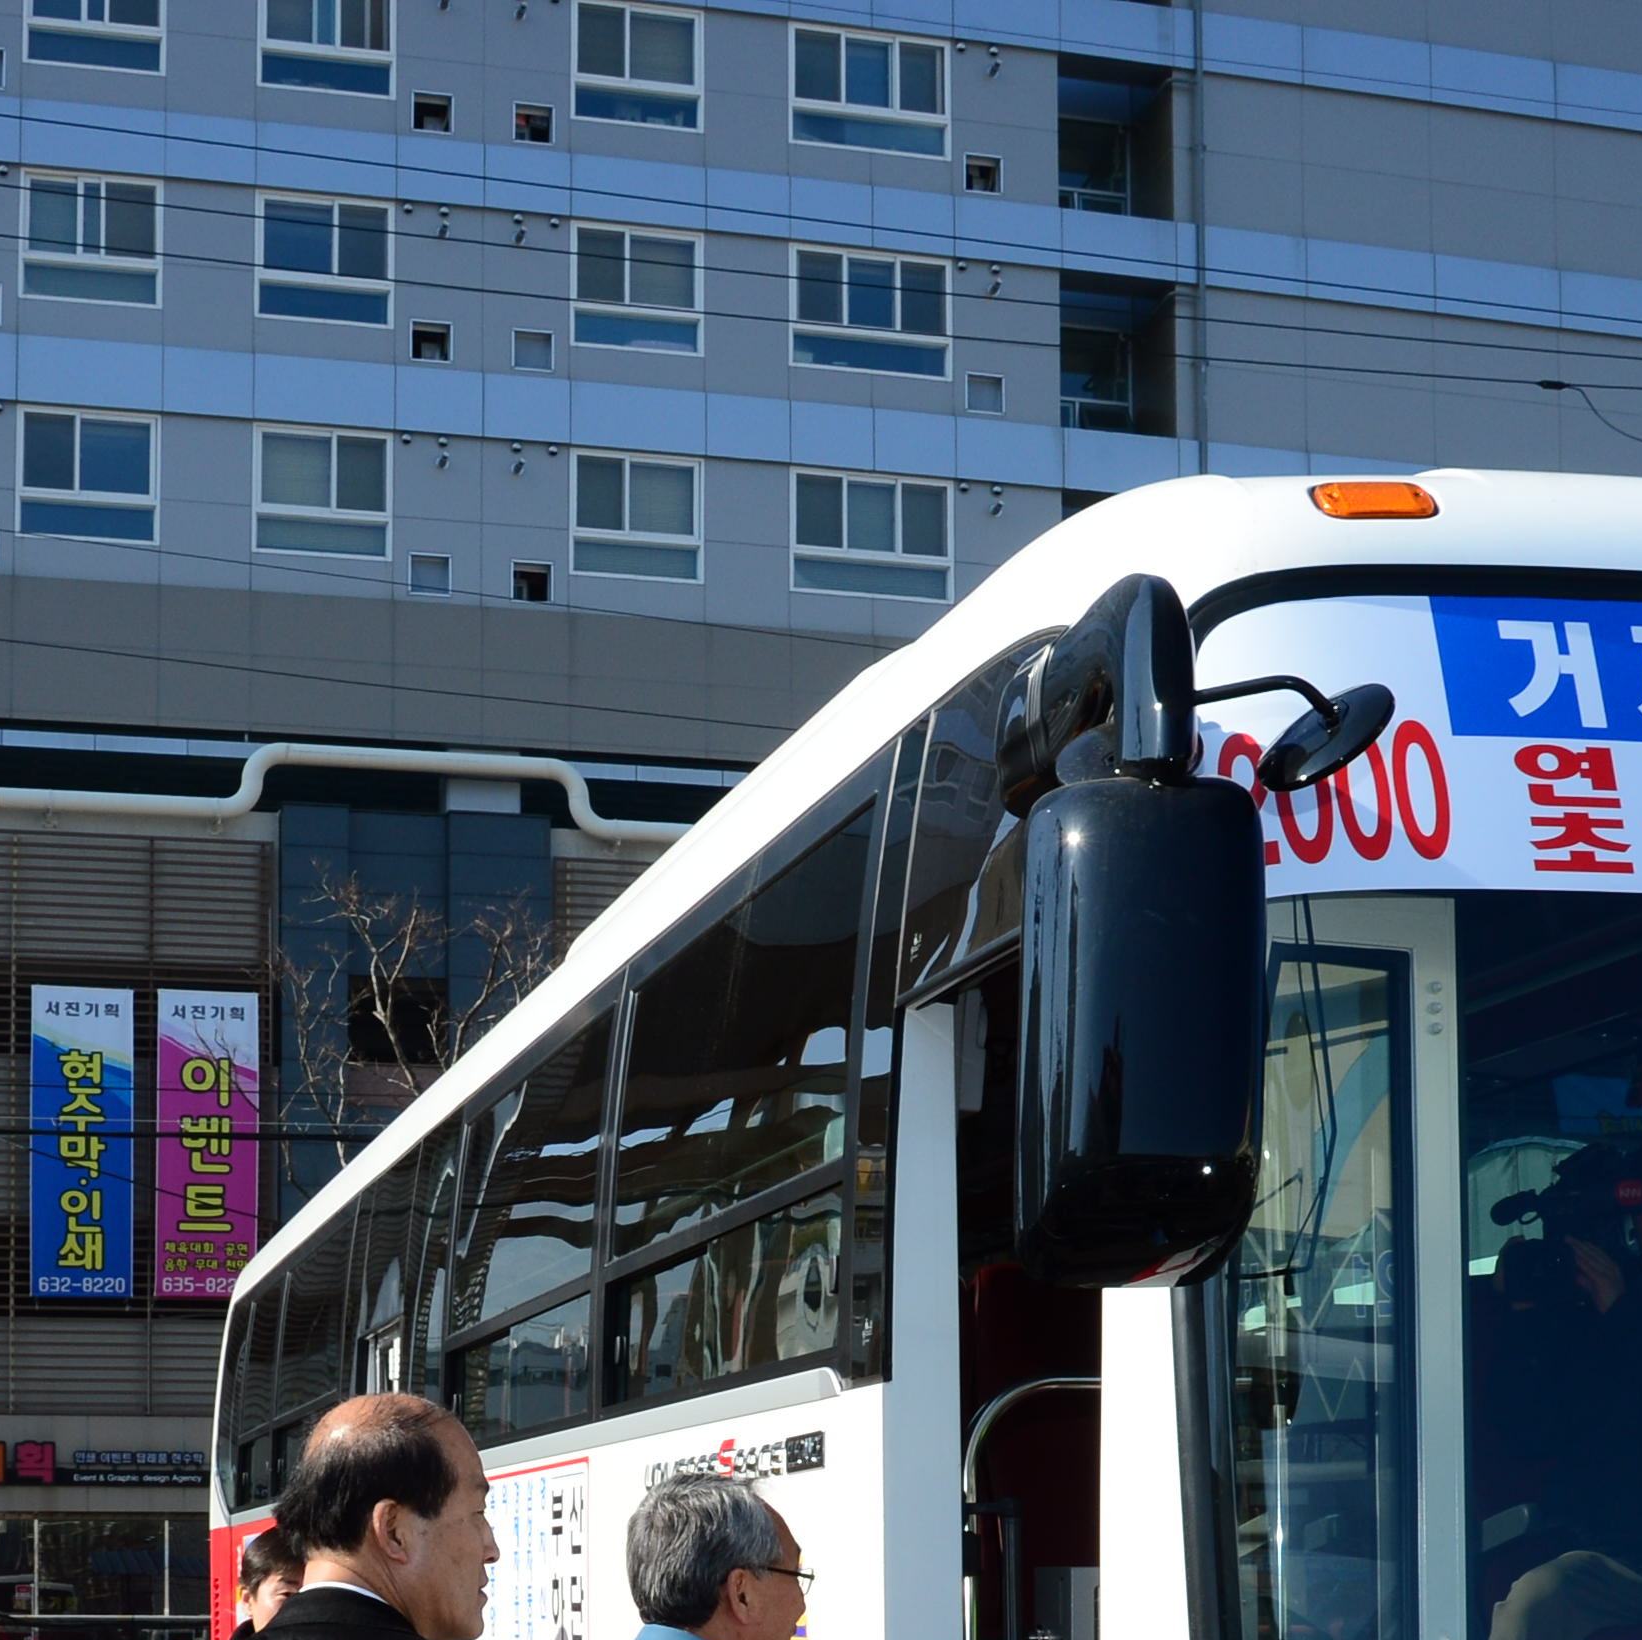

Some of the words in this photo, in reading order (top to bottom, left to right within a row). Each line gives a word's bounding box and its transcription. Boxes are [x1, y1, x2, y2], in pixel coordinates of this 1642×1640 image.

[1513, 743, 1635, 875] 연초
[44, 1000, 120, 1018] 서진기획
[170, 1004, 246, 1021] 서진기획
[177, 1057, 234, 1232] 이벤트
[37, 1276, 126, 1293] 632-8220
[161, 1276, 238, 1293] 635-822
[72, 1473, 97, 1483] Event
[106, 1473, 140, 1484] Graphic
[171, 1473, 203, 1484] Agency
